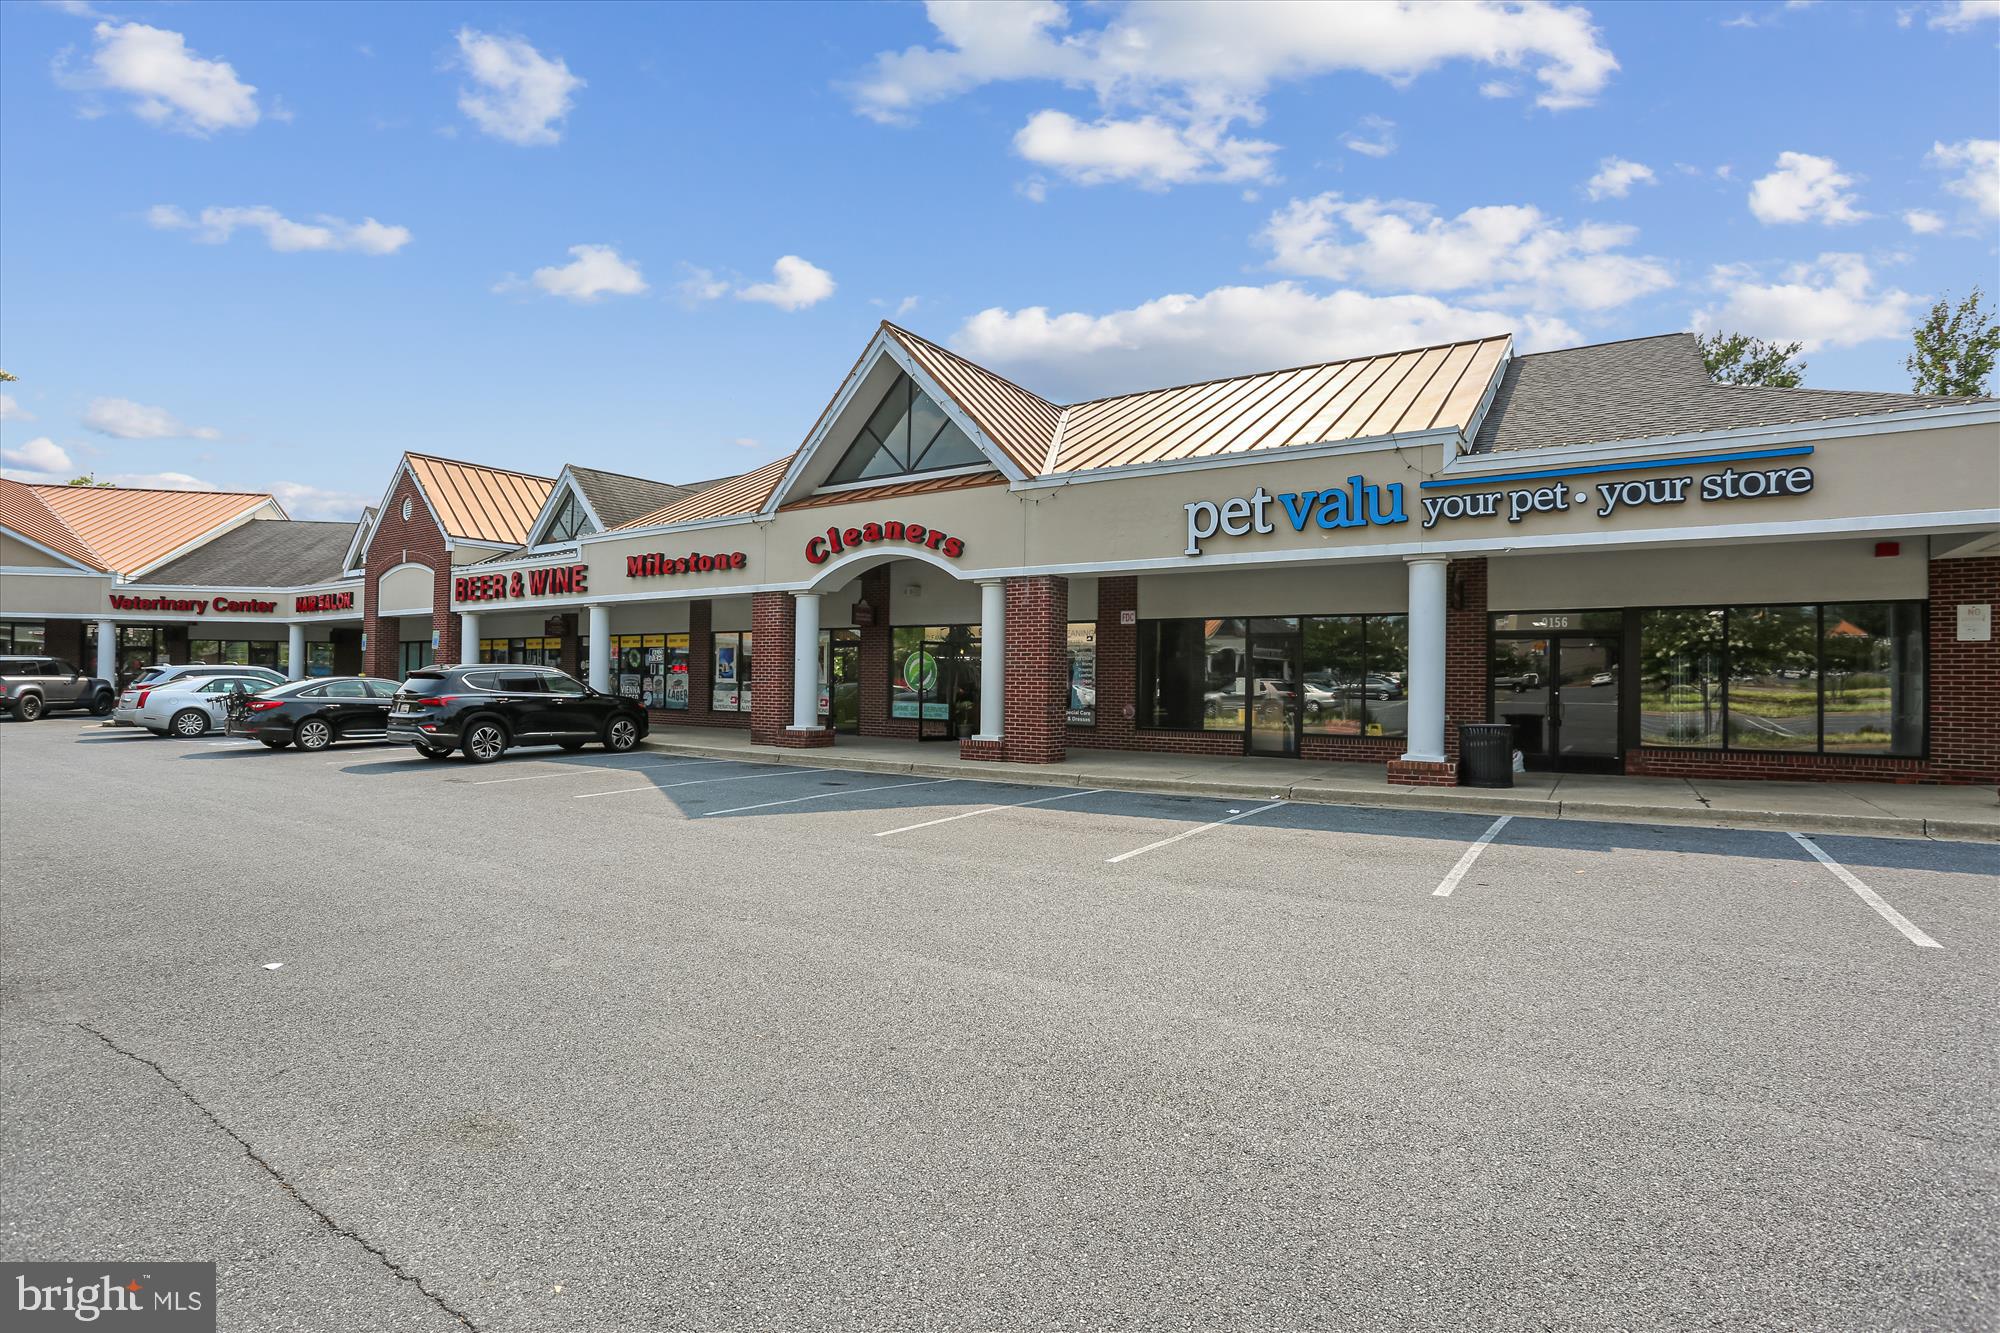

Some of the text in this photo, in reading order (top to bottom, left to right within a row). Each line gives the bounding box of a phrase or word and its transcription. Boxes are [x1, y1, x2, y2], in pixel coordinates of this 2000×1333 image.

[1421, 467, 1814, 529] your pet your store
[1184, 475, 1408, 555] pet valu
[805, 520, 965, 565] Cleaners
[626, 551, 747, 578] Milestone
[455, 564, 588, 602] BEER & WINE
[109, 594, 278, 615] Veterinary Center
[1122, 612, 1134, 622] FDC
[667, 688, 688, 702] LAGER
